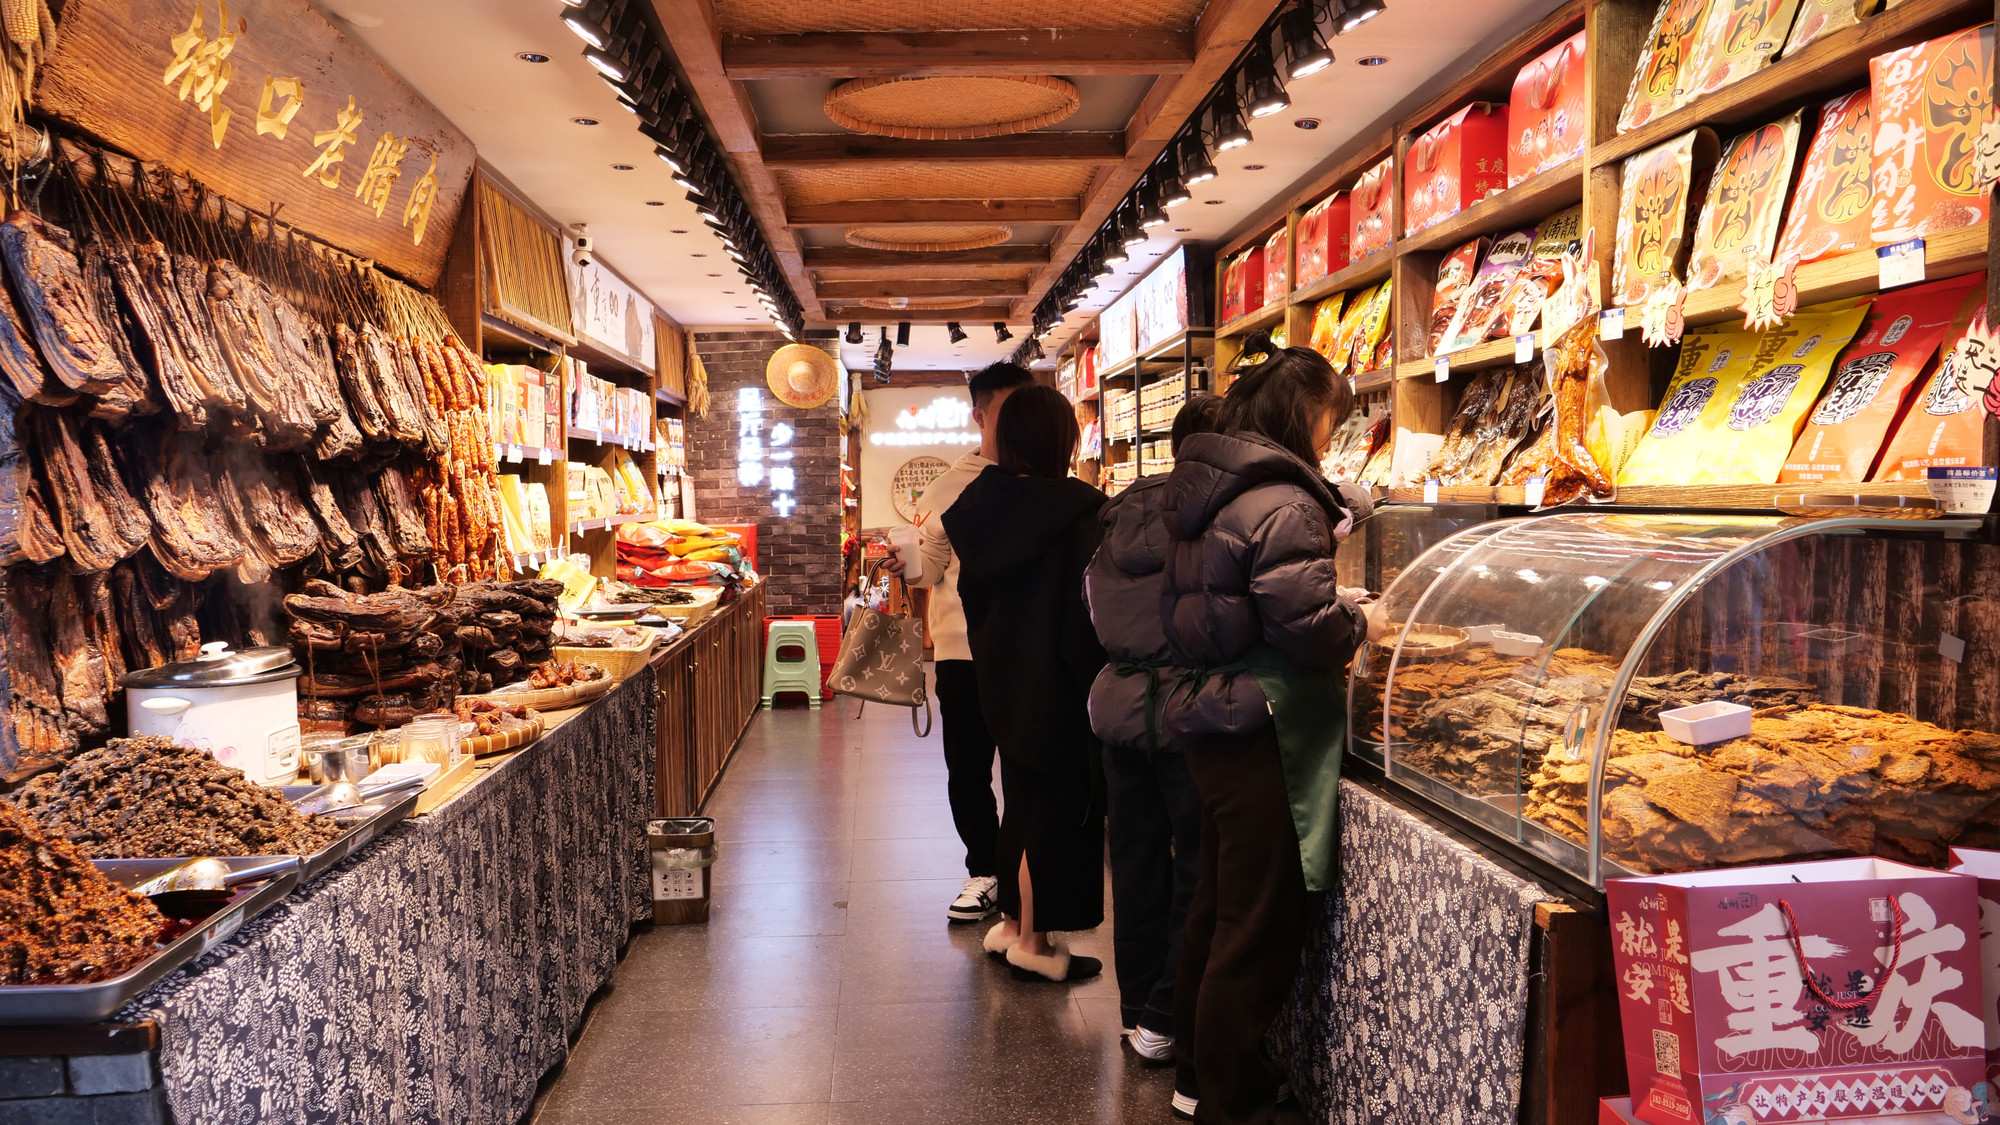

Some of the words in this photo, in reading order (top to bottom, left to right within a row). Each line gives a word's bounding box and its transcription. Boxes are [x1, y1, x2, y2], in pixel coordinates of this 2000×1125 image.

[1616, 911, 1688, 964] 就是
[1624, 964, 1692, 1014] 安逸
[1691, 892, 1985, 1057] 重庆
[1755, 1083, 1944, 1109] 让特产与服务温暖人心
